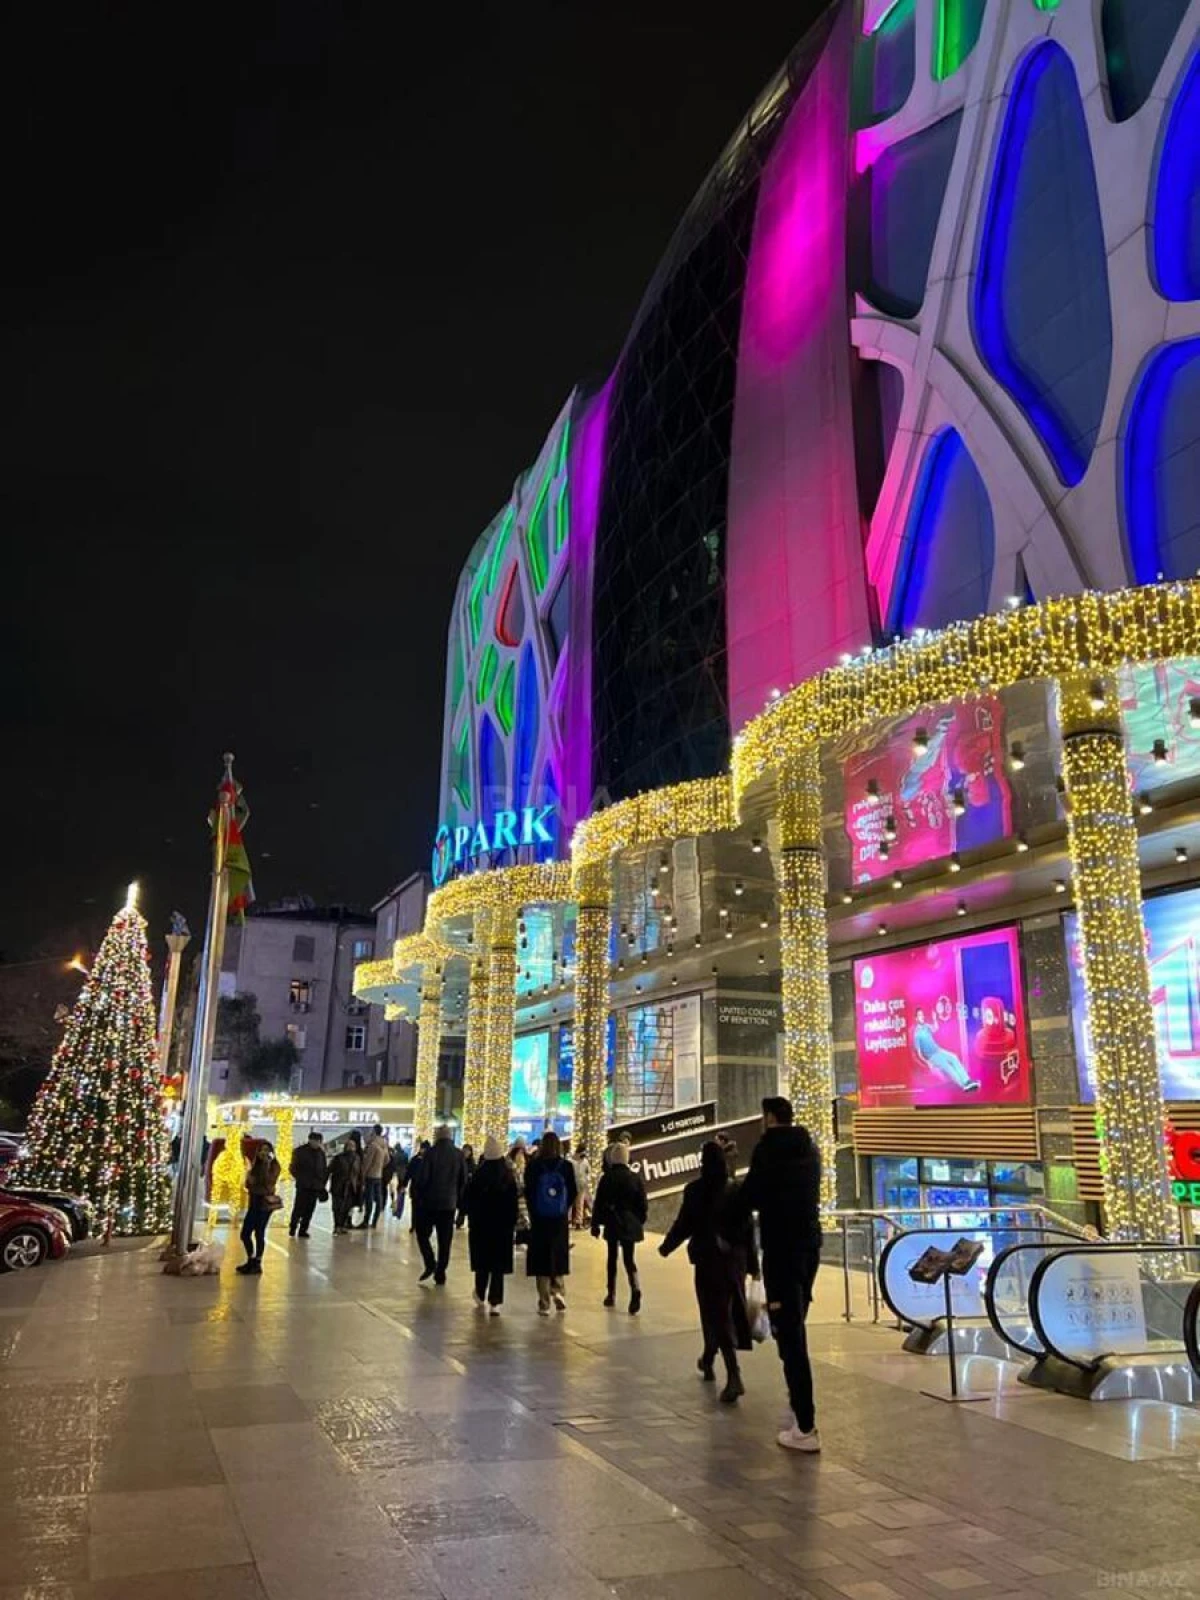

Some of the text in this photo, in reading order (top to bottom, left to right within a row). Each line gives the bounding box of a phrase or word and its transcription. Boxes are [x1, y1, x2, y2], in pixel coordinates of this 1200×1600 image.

[454, 804, 556, 861] PARK
[719, 1007, 778, 1019] UNITED COLORS
[863, 999, 887, 1015] Daha
[719, 1015, 729, 1024] OF
[642, 1150, 704, 1181] humm
